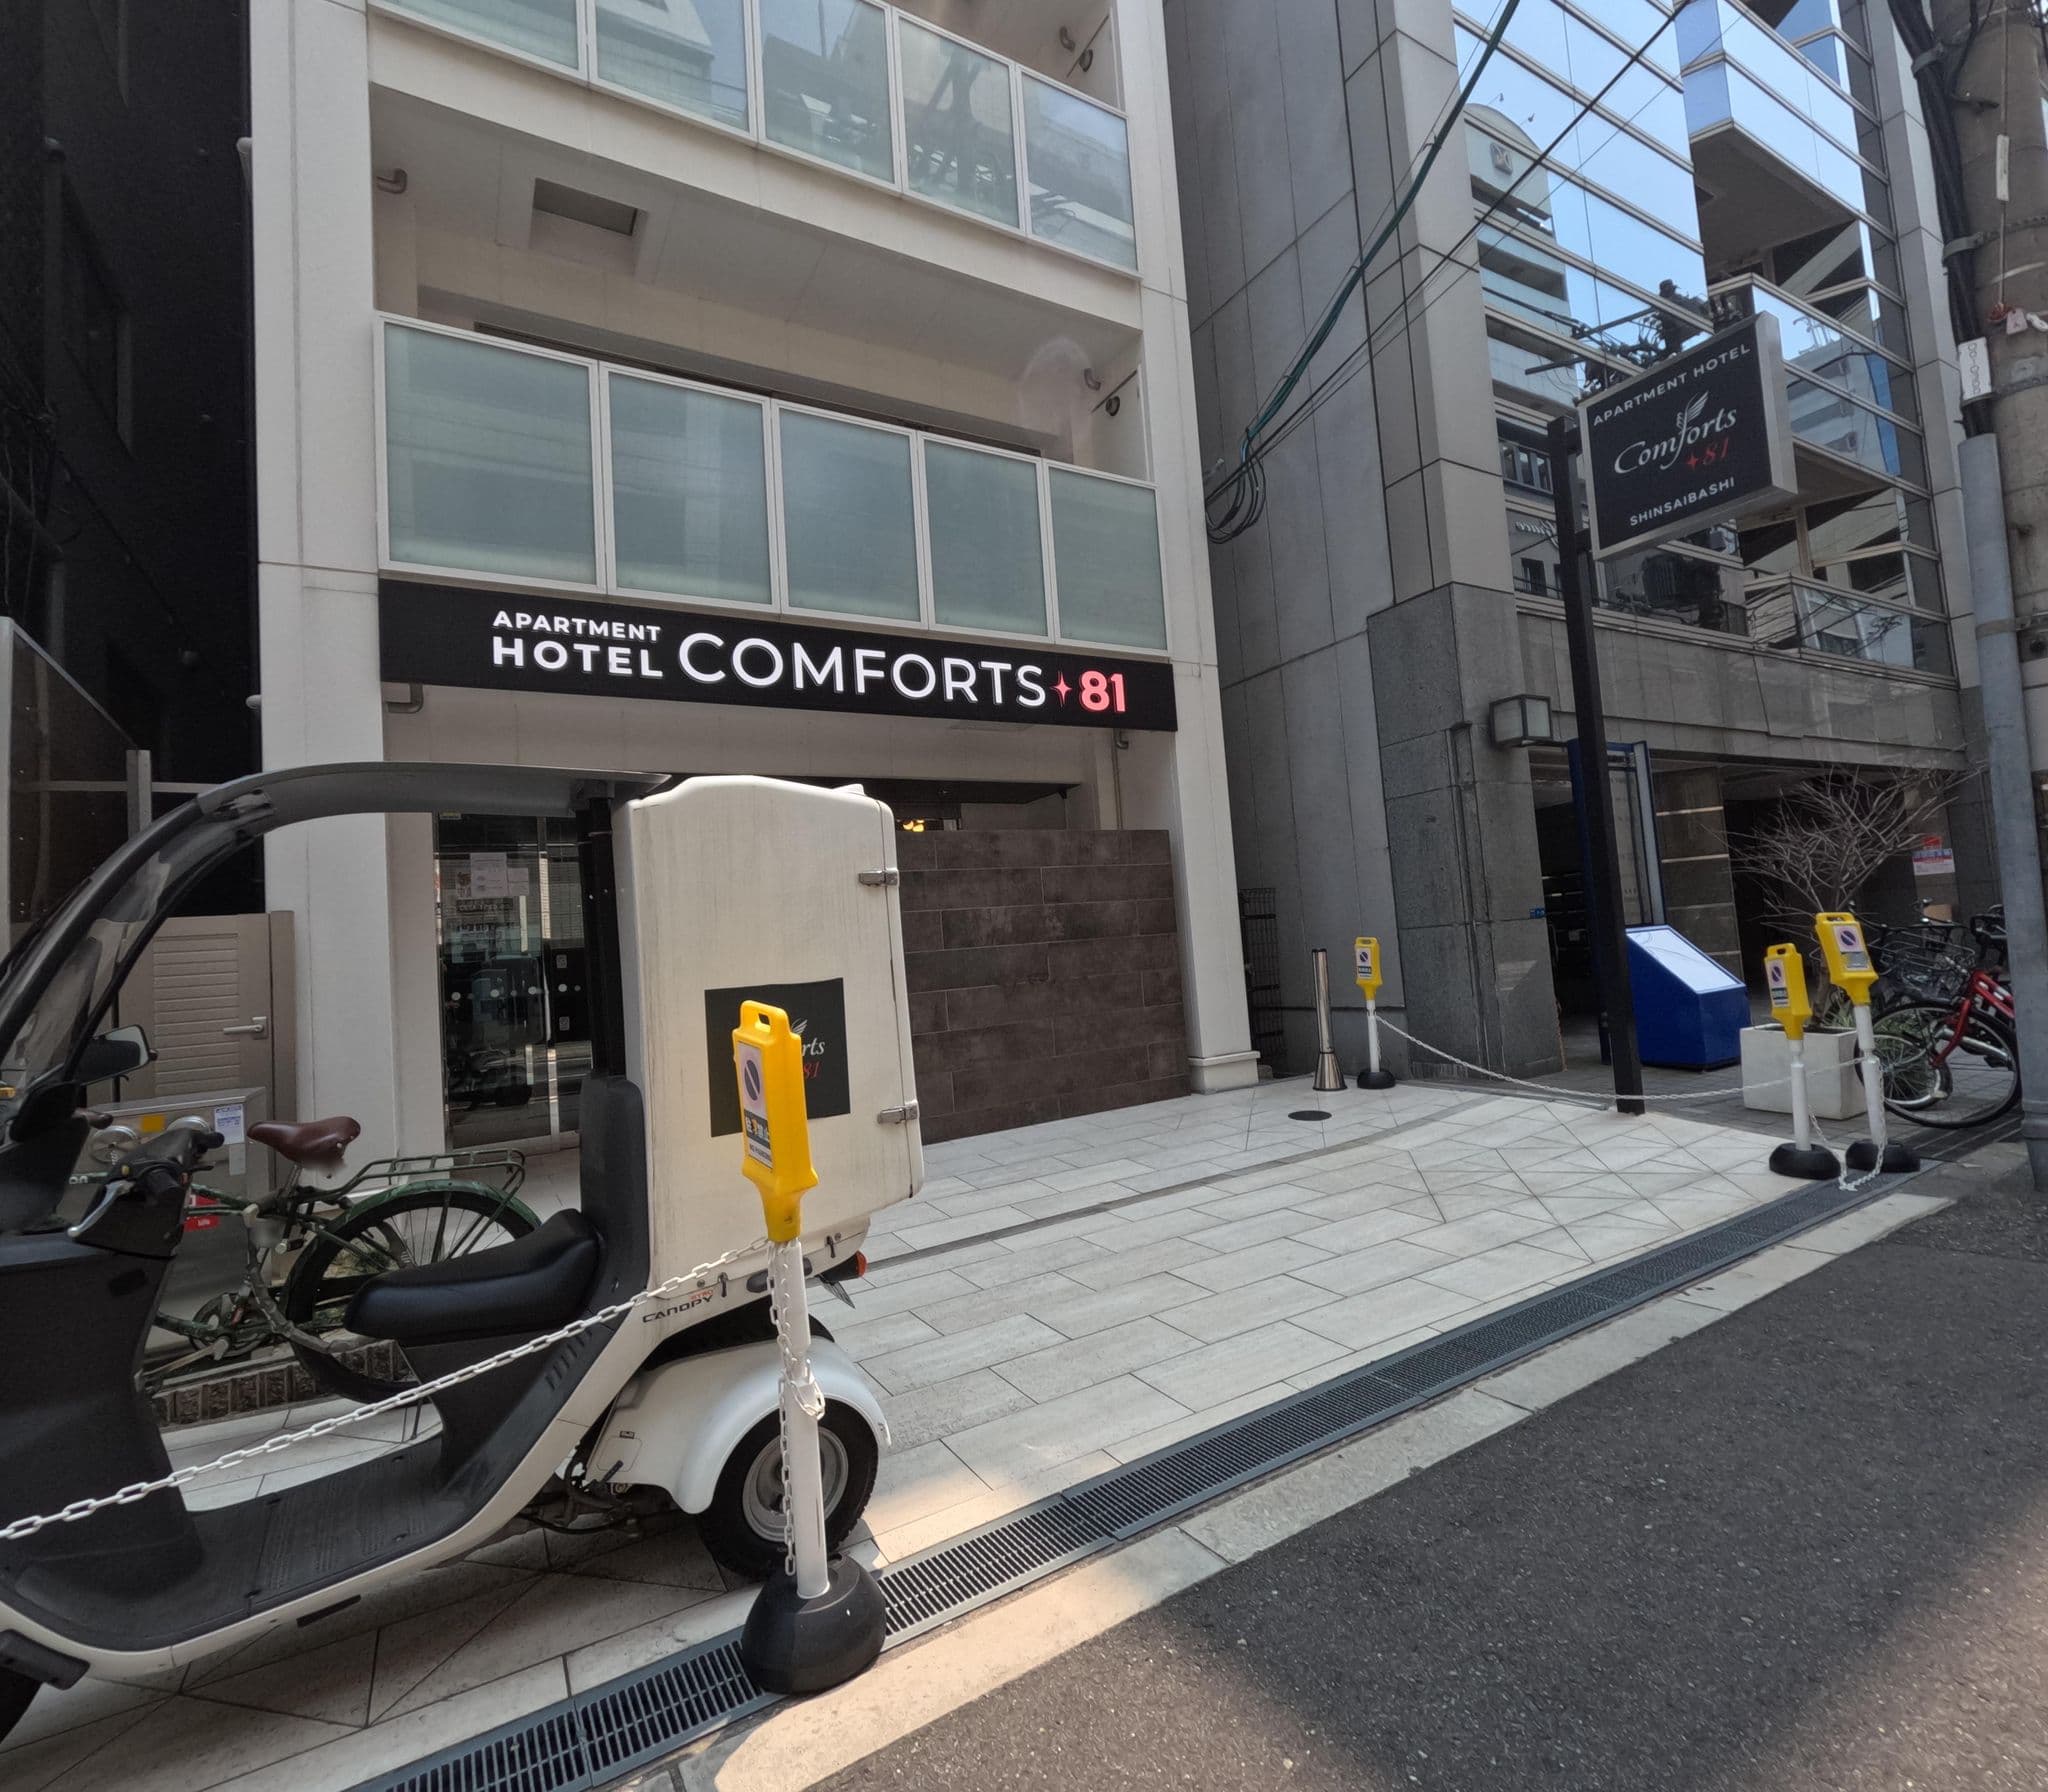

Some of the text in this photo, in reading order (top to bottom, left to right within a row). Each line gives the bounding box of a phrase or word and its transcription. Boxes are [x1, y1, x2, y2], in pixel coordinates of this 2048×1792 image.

[1593, 344, 1751, 426] APARTMENT HOTEL
[1614, 390, 1738, 475] Comforts
[1629, 476, 1735, 527] SHINSAIBASHI
[492, 610, 662, 643] APARTMENT
[492, 636, 664, 679] HOTEL
[678, 632, 1046, 707] COMFORTS
[642, 1295, 713, 1324] CANOPY
